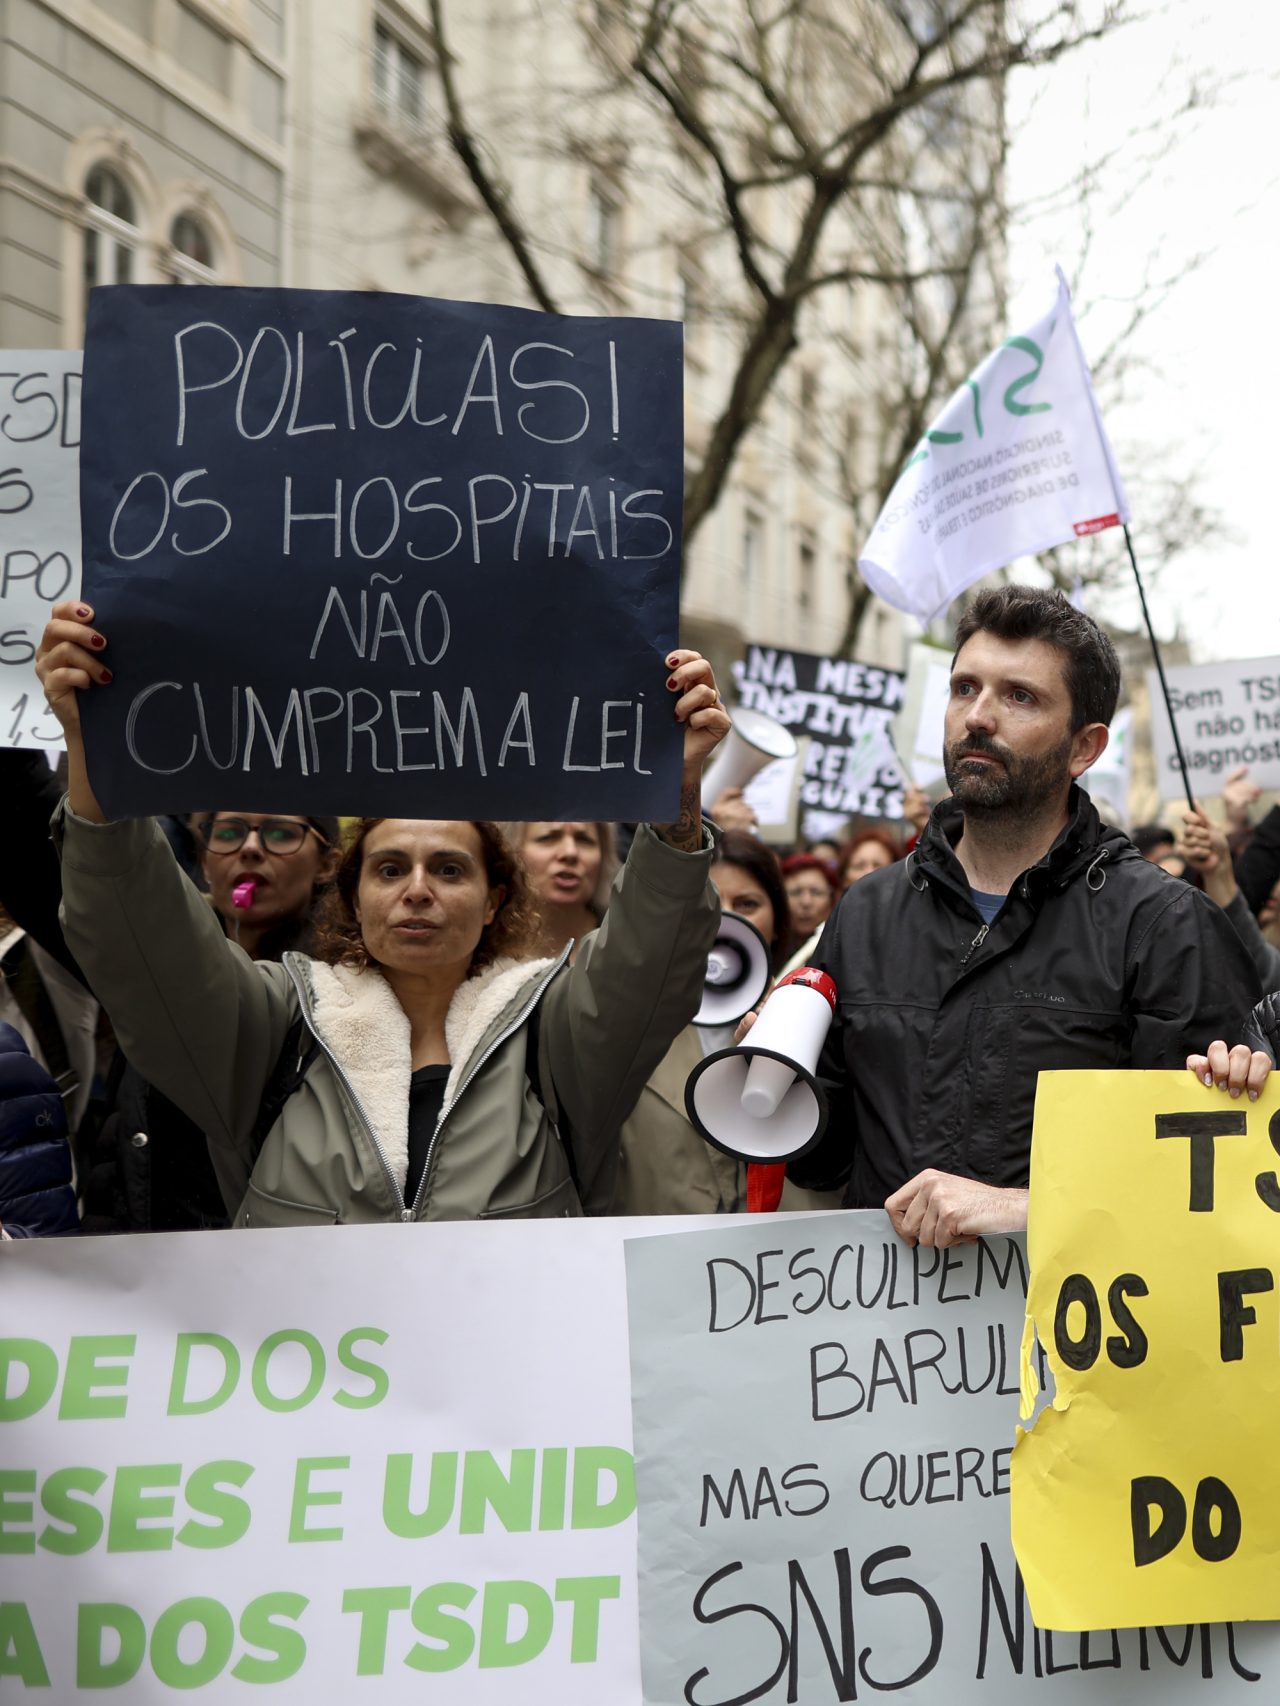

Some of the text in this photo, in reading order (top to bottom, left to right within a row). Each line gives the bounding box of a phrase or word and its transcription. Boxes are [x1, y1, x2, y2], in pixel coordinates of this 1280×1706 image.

[108, 468, 674, 564] OS HOSPITAIS
[309, 572, 451, 666] NÃO
[125, 681, 488, 777] CUMPREM
[498, 691, 537, 768] A
[1167, 685, 1223, 713] Sem
[1196, 713, 1245, 738] não
[1053, 1273, 1150, 1371] OS
[166, 1326, 391, 1417] DOS
[288, 1455, 351, 1544] E
[381, 1445, 638, 1540] UNID
[699, 1447, 1014, 1528] MAS QUERE
[1129, 1475, 1242, 1568] DO
[76, 1590, 311, 1691] DOS
[340, 1574, 622, 1677] TSDT
[684, 1543, 944, 1706] SNS
